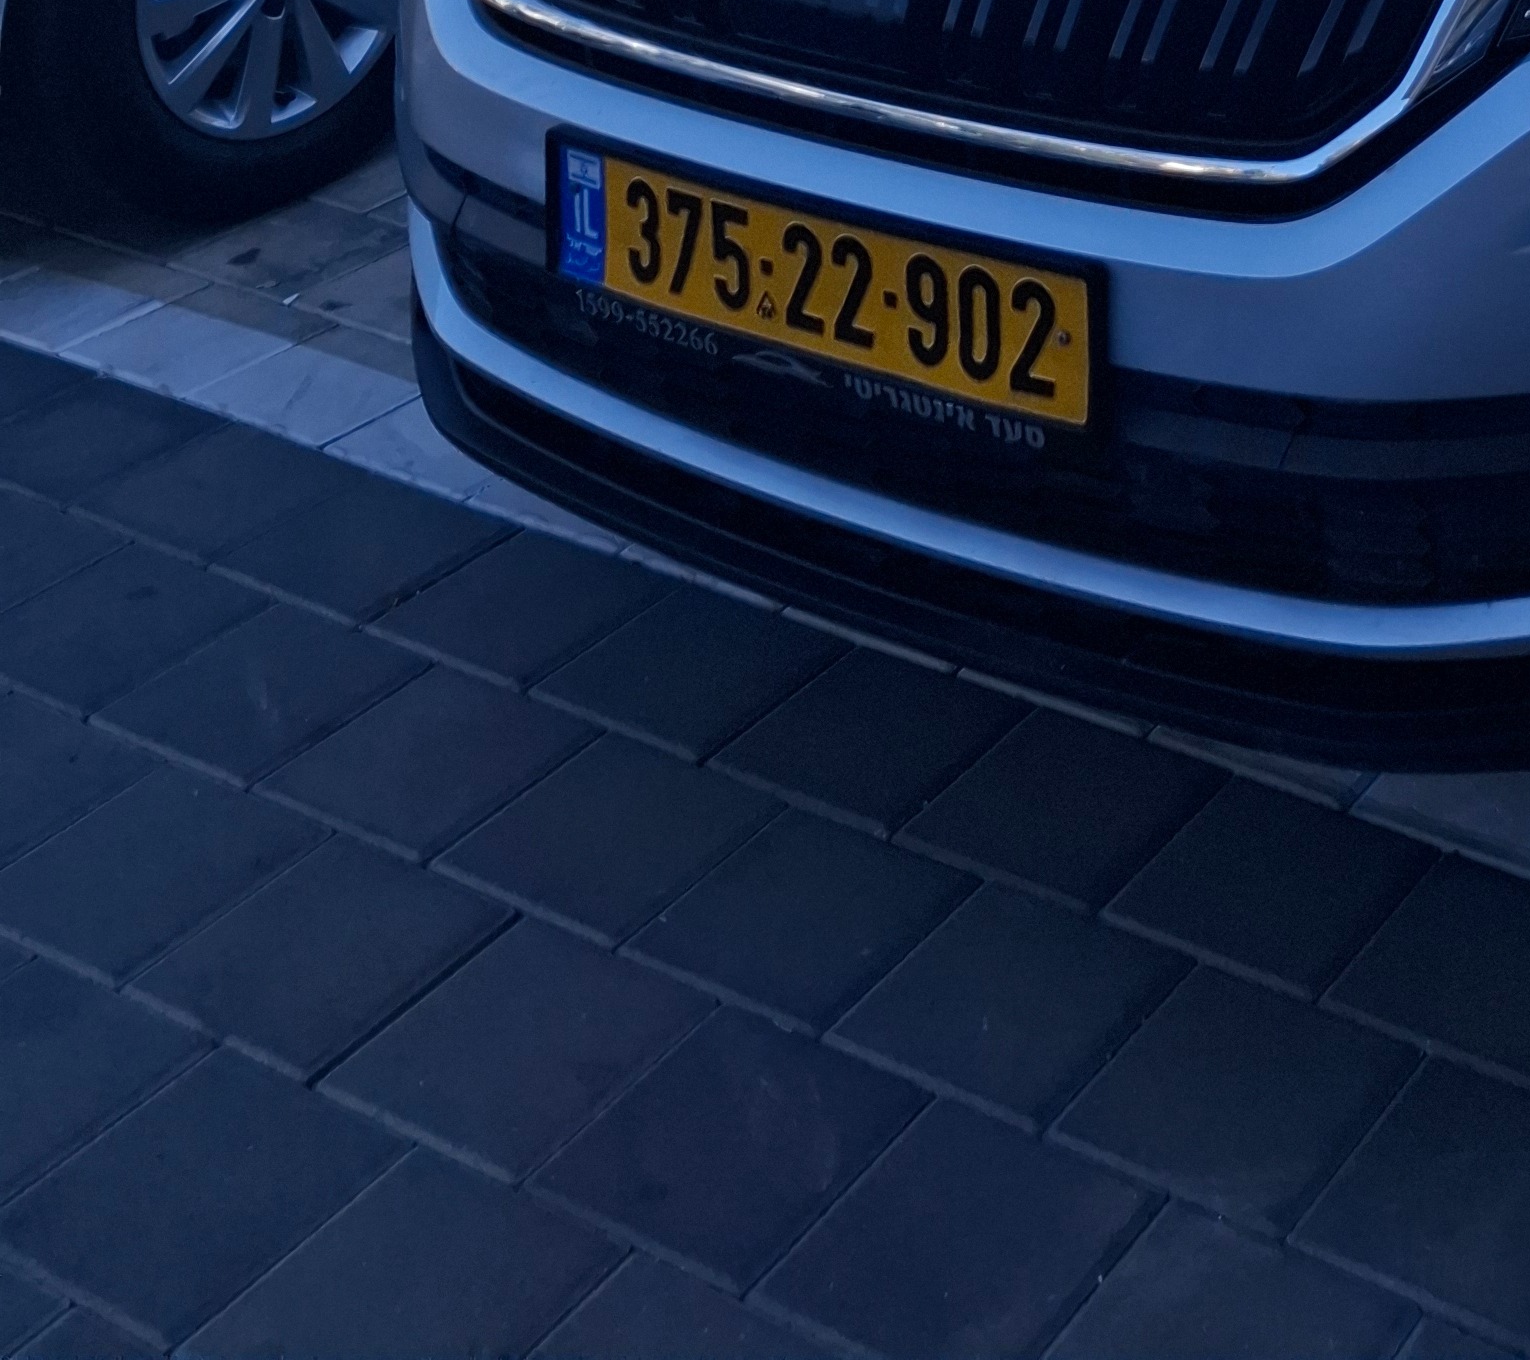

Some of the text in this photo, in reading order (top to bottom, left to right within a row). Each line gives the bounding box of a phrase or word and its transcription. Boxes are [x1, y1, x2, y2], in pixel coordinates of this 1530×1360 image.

[573, 188, 599, 239] IL
[575, 289, 719, 355] 1599-552266
[844, 373, 1046, 449] סעד אינטגריטי
